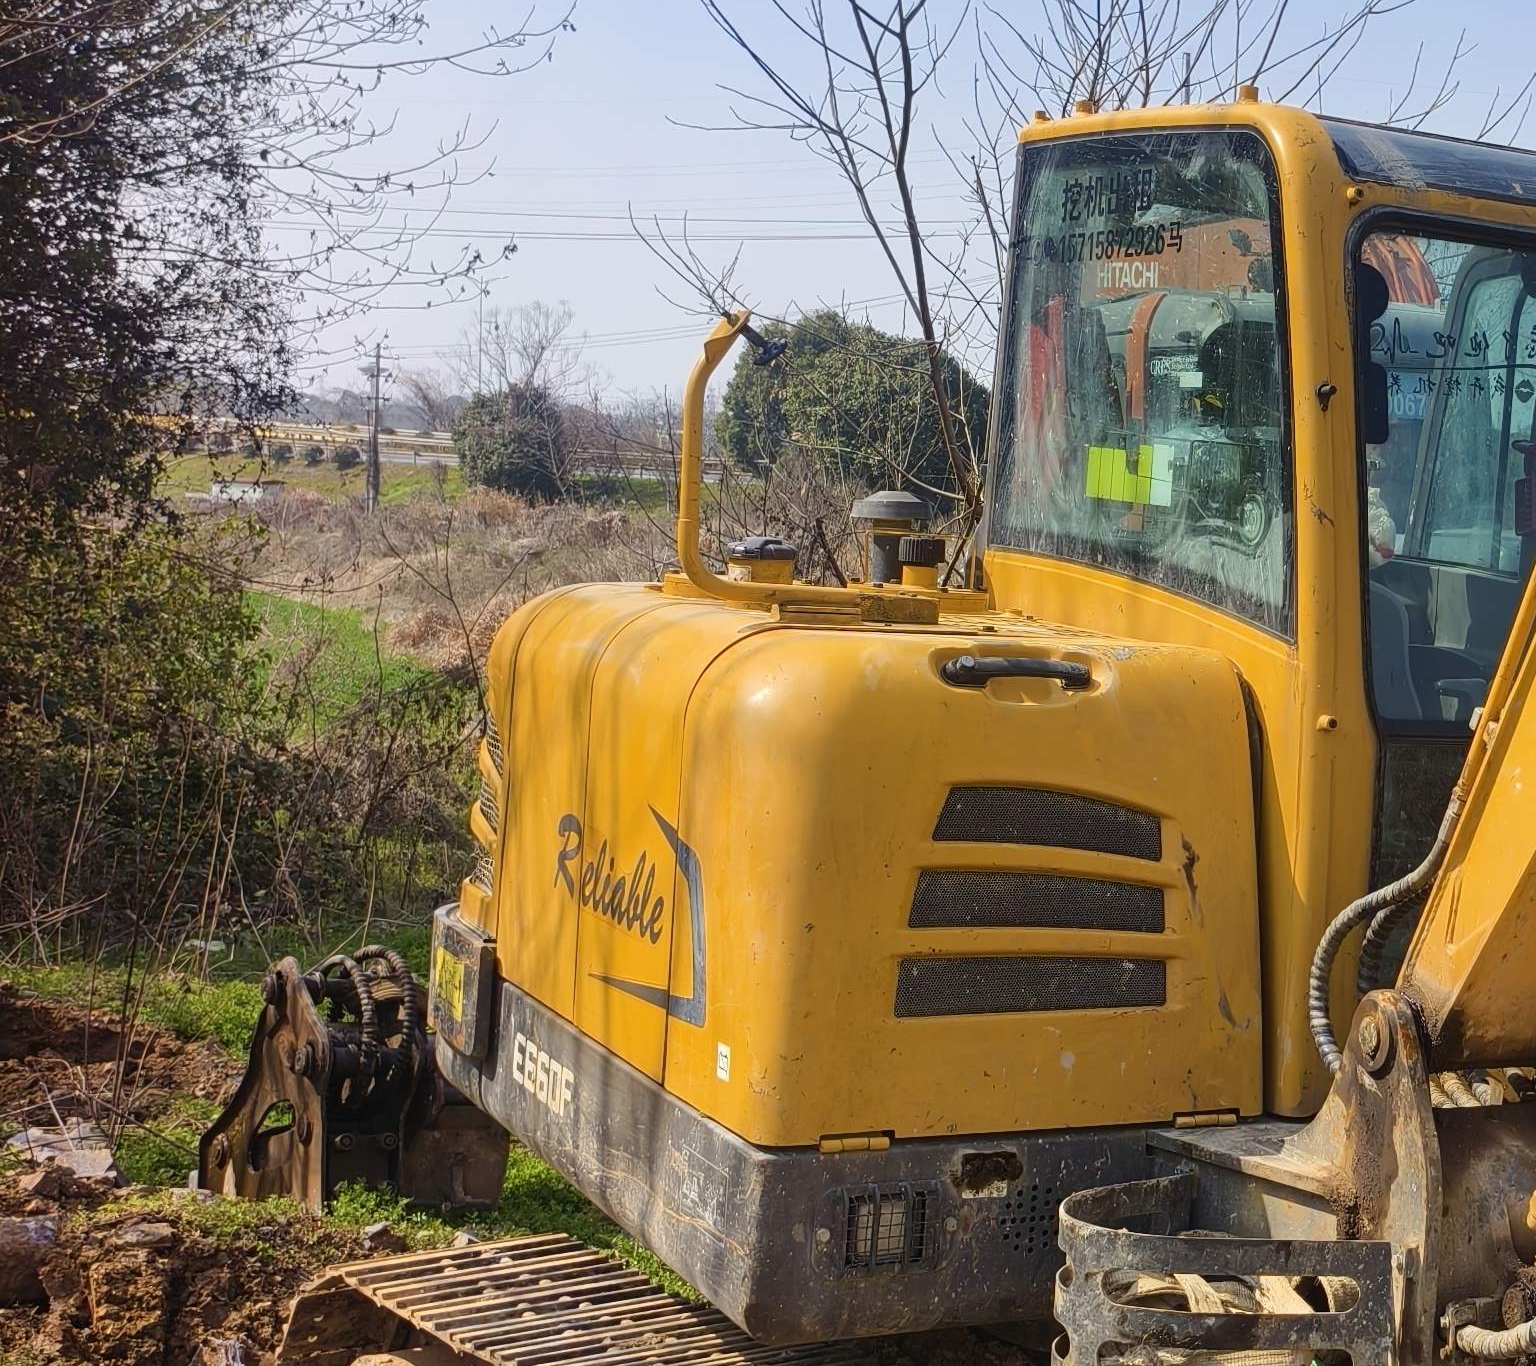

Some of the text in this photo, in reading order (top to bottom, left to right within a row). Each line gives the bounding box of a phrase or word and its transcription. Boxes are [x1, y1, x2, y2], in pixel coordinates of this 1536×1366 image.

[1061, 168, 1153, 223] 挖机出租
[1096, 261, 1159, 289] HITACHI
[553, 813, 665, 945] Reliable
[512, 1032, 575, 1117] E660F
